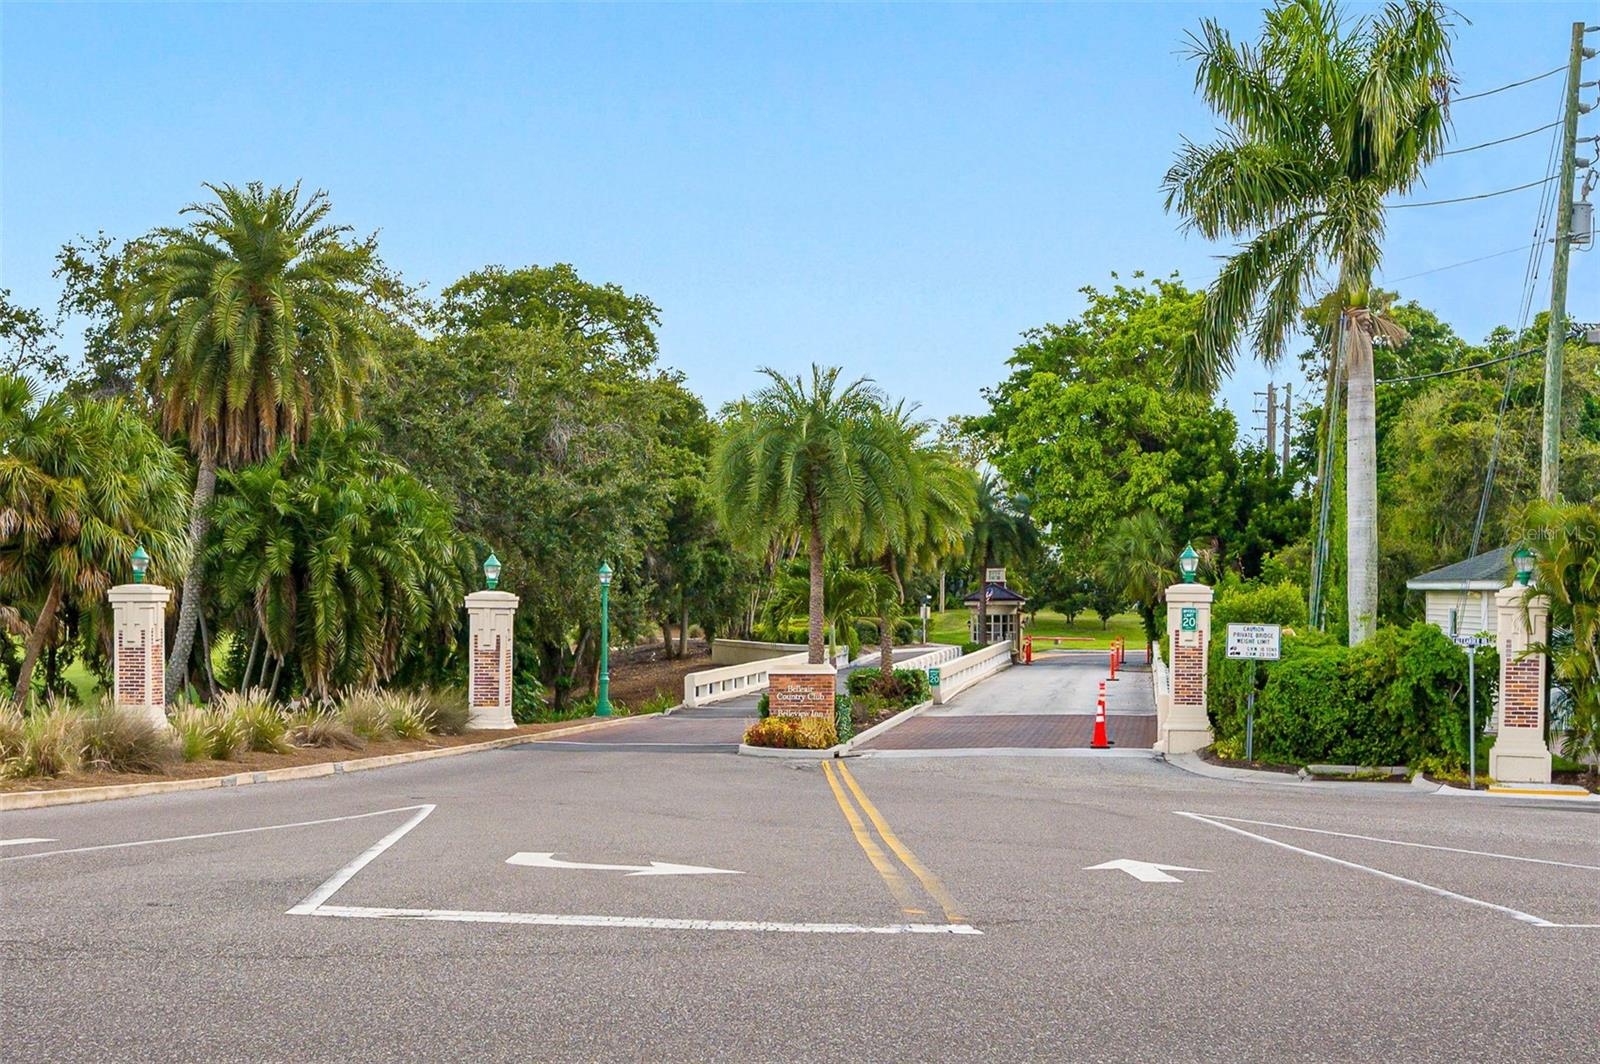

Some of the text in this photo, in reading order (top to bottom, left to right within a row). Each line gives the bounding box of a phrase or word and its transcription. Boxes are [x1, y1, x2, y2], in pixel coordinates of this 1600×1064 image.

[1182, 617, 1196, 627] 20
[929, 675, 940, 683] 20
[776, 692, 825, 702] Country Club
